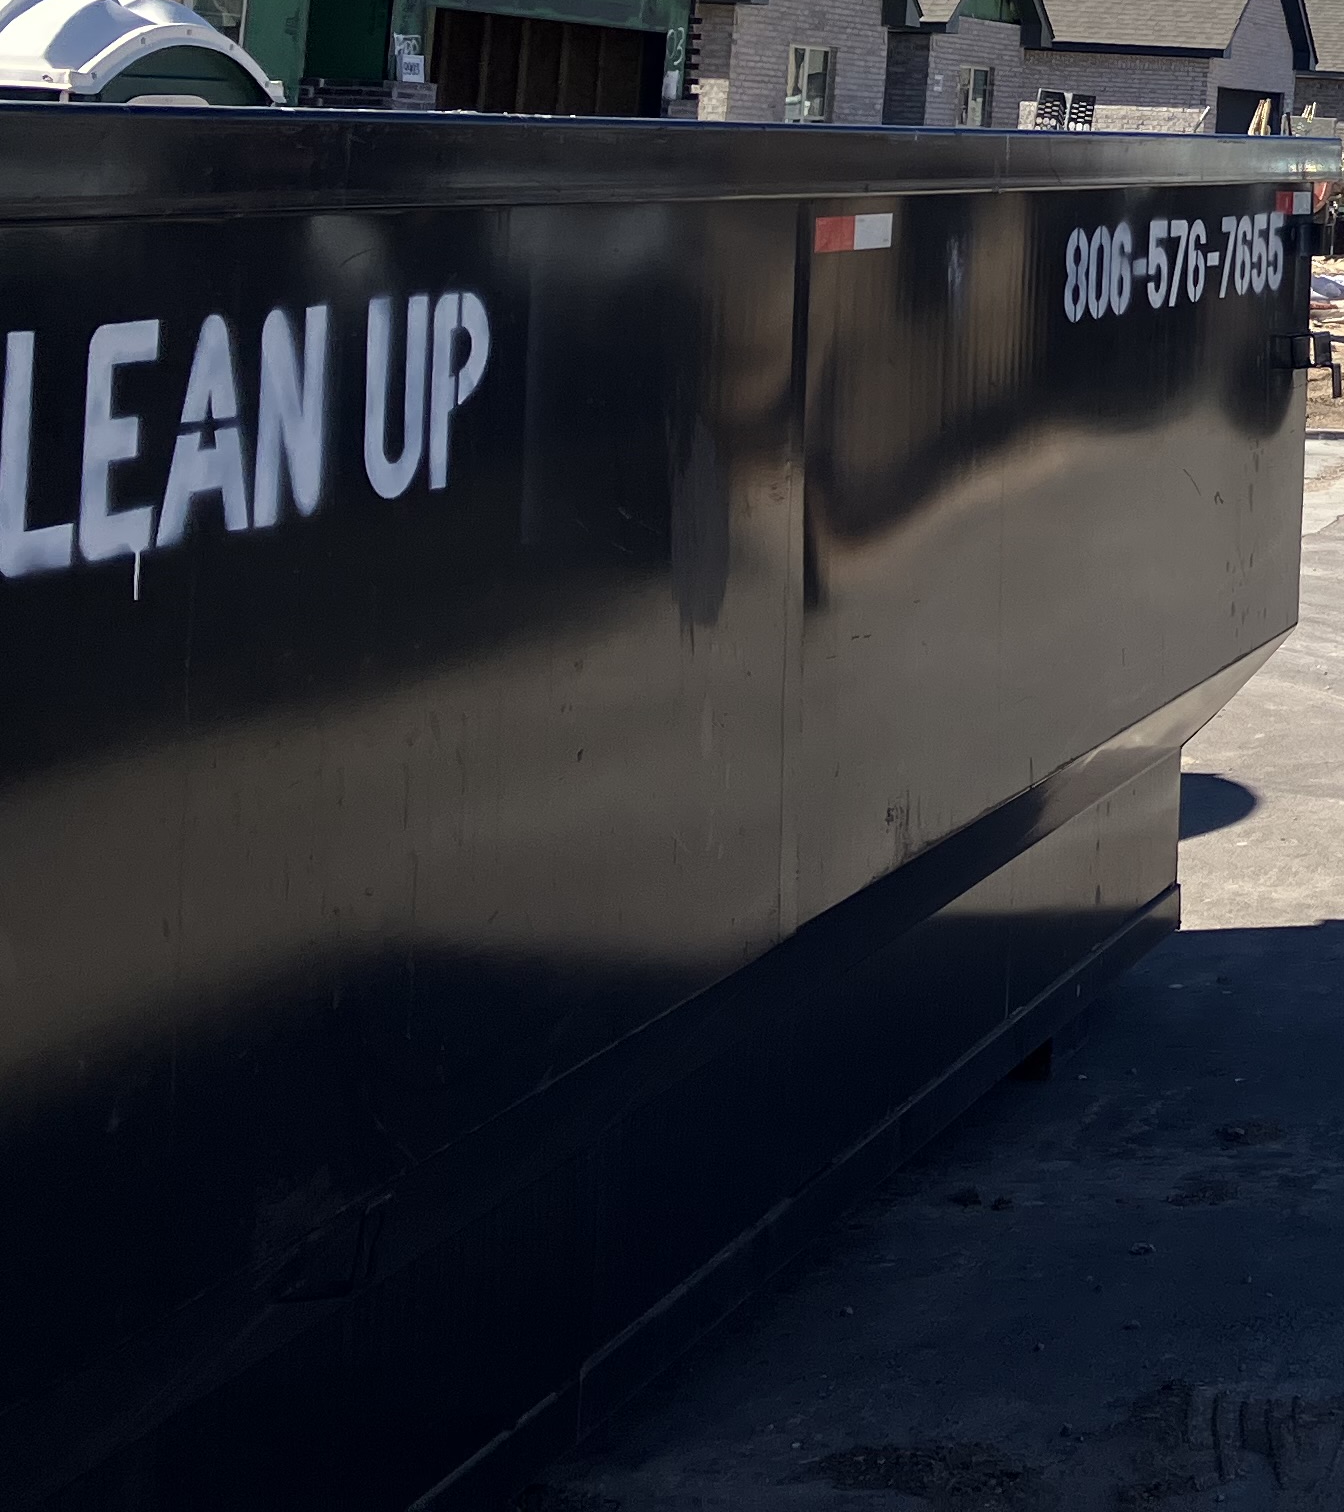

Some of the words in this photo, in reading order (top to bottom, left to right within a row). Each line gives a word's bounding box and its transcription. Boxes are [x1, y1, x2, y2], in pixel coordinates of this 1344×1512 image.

[1064, 211, 1284, 323] 806-576-7655
[0, 304, 328, 579] LEAN
[364, 290, 491, 499] UP
